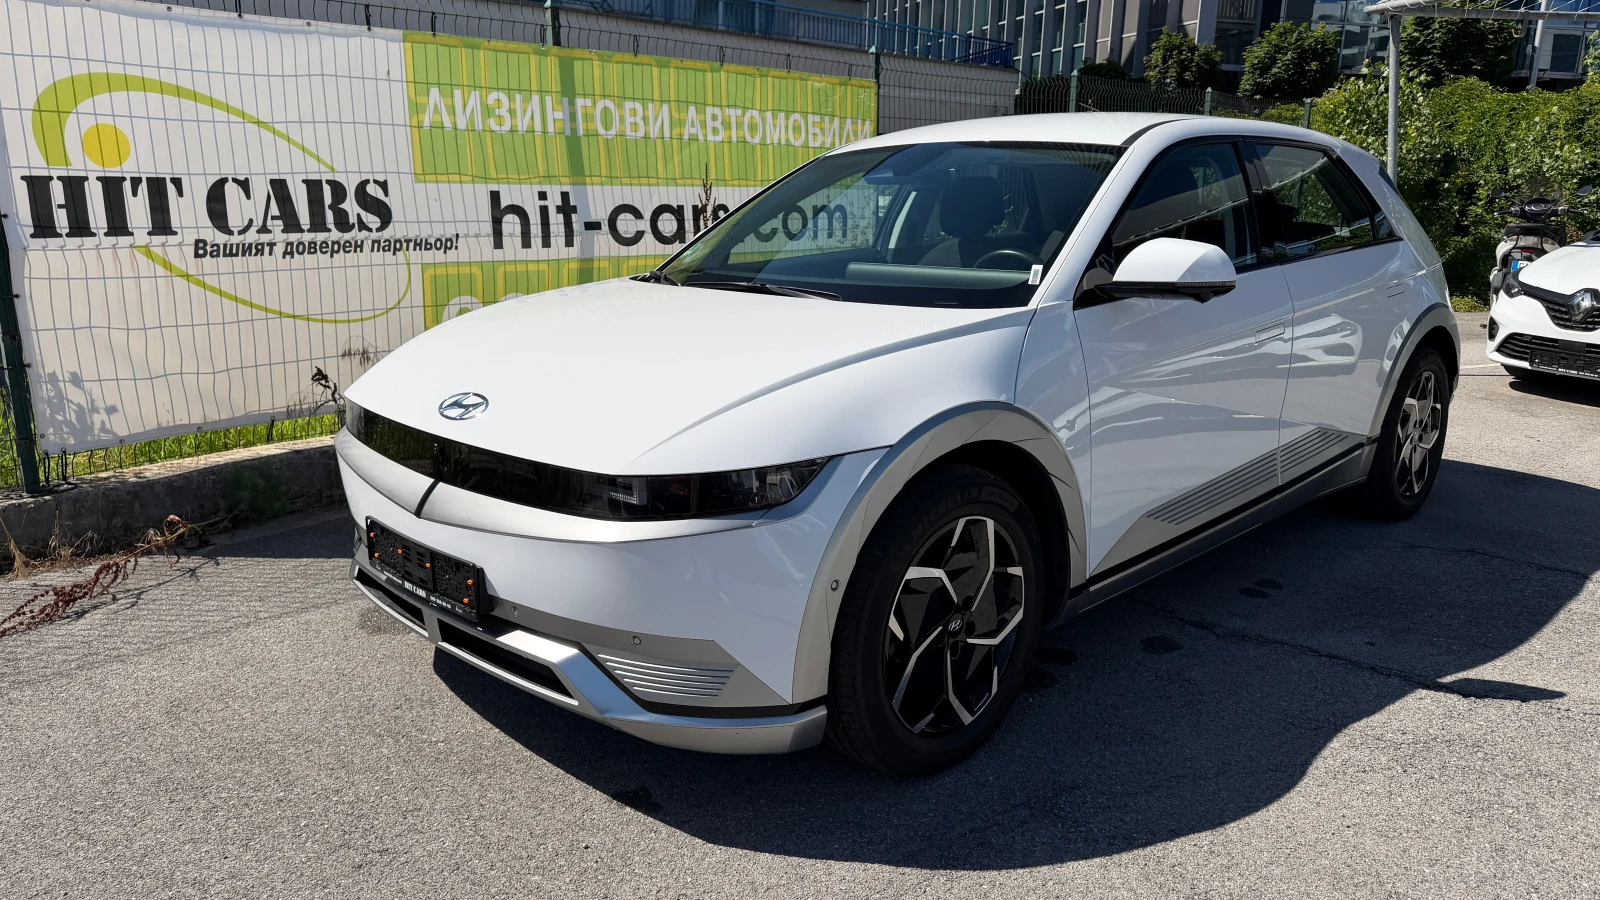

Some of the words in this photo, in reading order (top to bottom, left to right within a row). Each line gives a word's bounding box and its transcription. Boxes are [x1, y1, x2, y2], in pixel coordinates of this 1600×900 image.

[423, 87, 670, 141] ЛИЗИНГОВИ
[682, 105, 871, 148] АВТОМОБИЛИ
[20, 175, 184, 239] HIT
[205, 176, 393, 237] CARS
[490, 191, 848, 250] hit-carcom
[193, 237, 277, 260] Вашият
[282, 238, 366, 258] доверен
[370, 233, 460, 256] партньор!
[912, 487, 980, 541] MICHELIN
